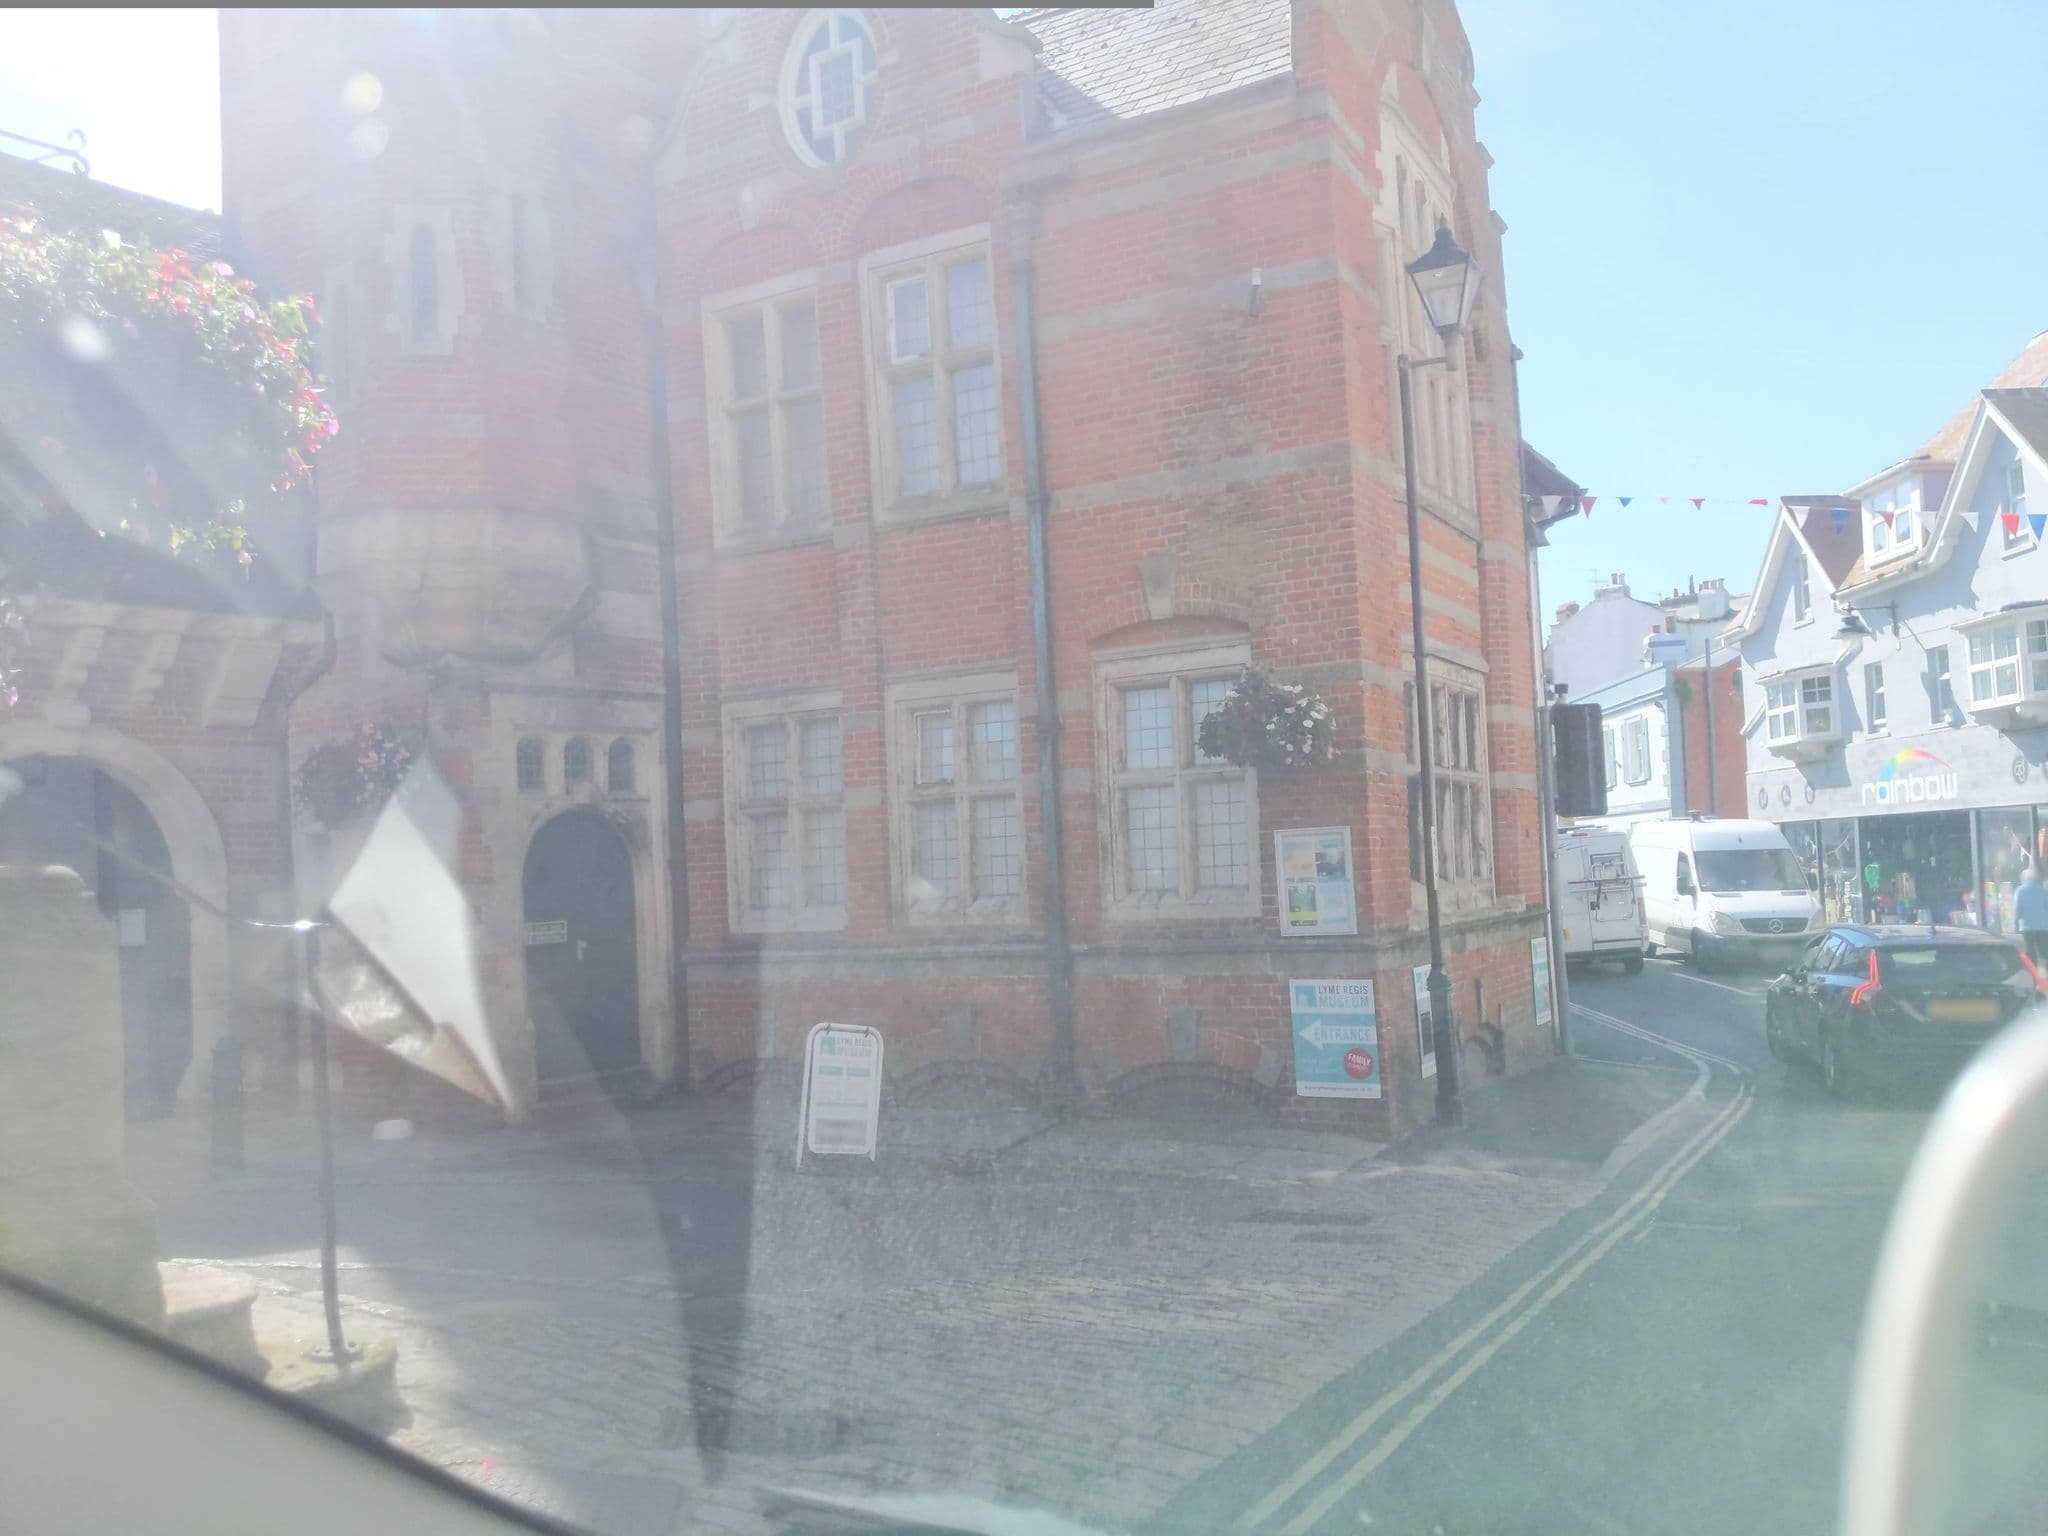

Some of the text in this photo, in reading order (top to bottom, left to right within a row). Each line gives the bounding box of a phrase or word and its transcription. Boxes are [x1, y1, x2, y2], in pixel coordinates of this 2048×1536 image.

[1861, 772, 1959, 806] rainbow
[1318, 985, 1369, 996] LYME REGIS
[1318, 995, 1369, 1008] MUSEUM
[1314, 1028, 1370, 1041] ENTRANCE
